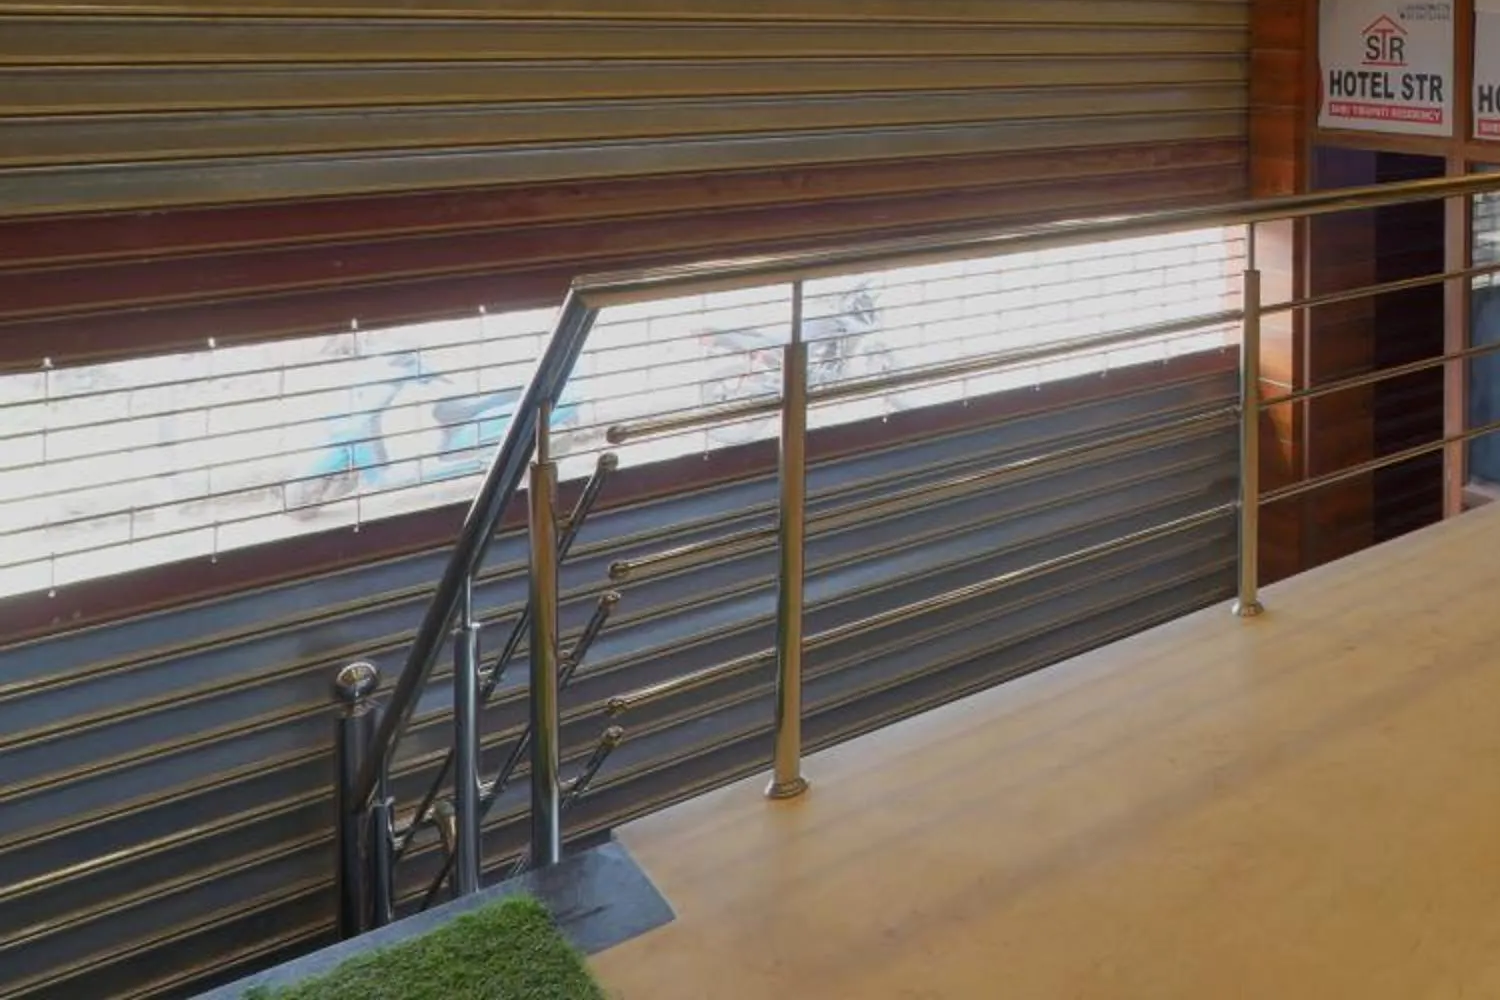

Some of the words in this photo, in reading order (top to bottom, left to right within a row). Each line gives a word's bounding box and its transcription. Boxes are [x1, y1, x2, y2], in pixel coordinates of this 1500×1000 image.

[1366, 29, 1405, 62] STR
[1329, 70, 1394, 100] HOTEL
[1401, 73, 1443, 102] STR
